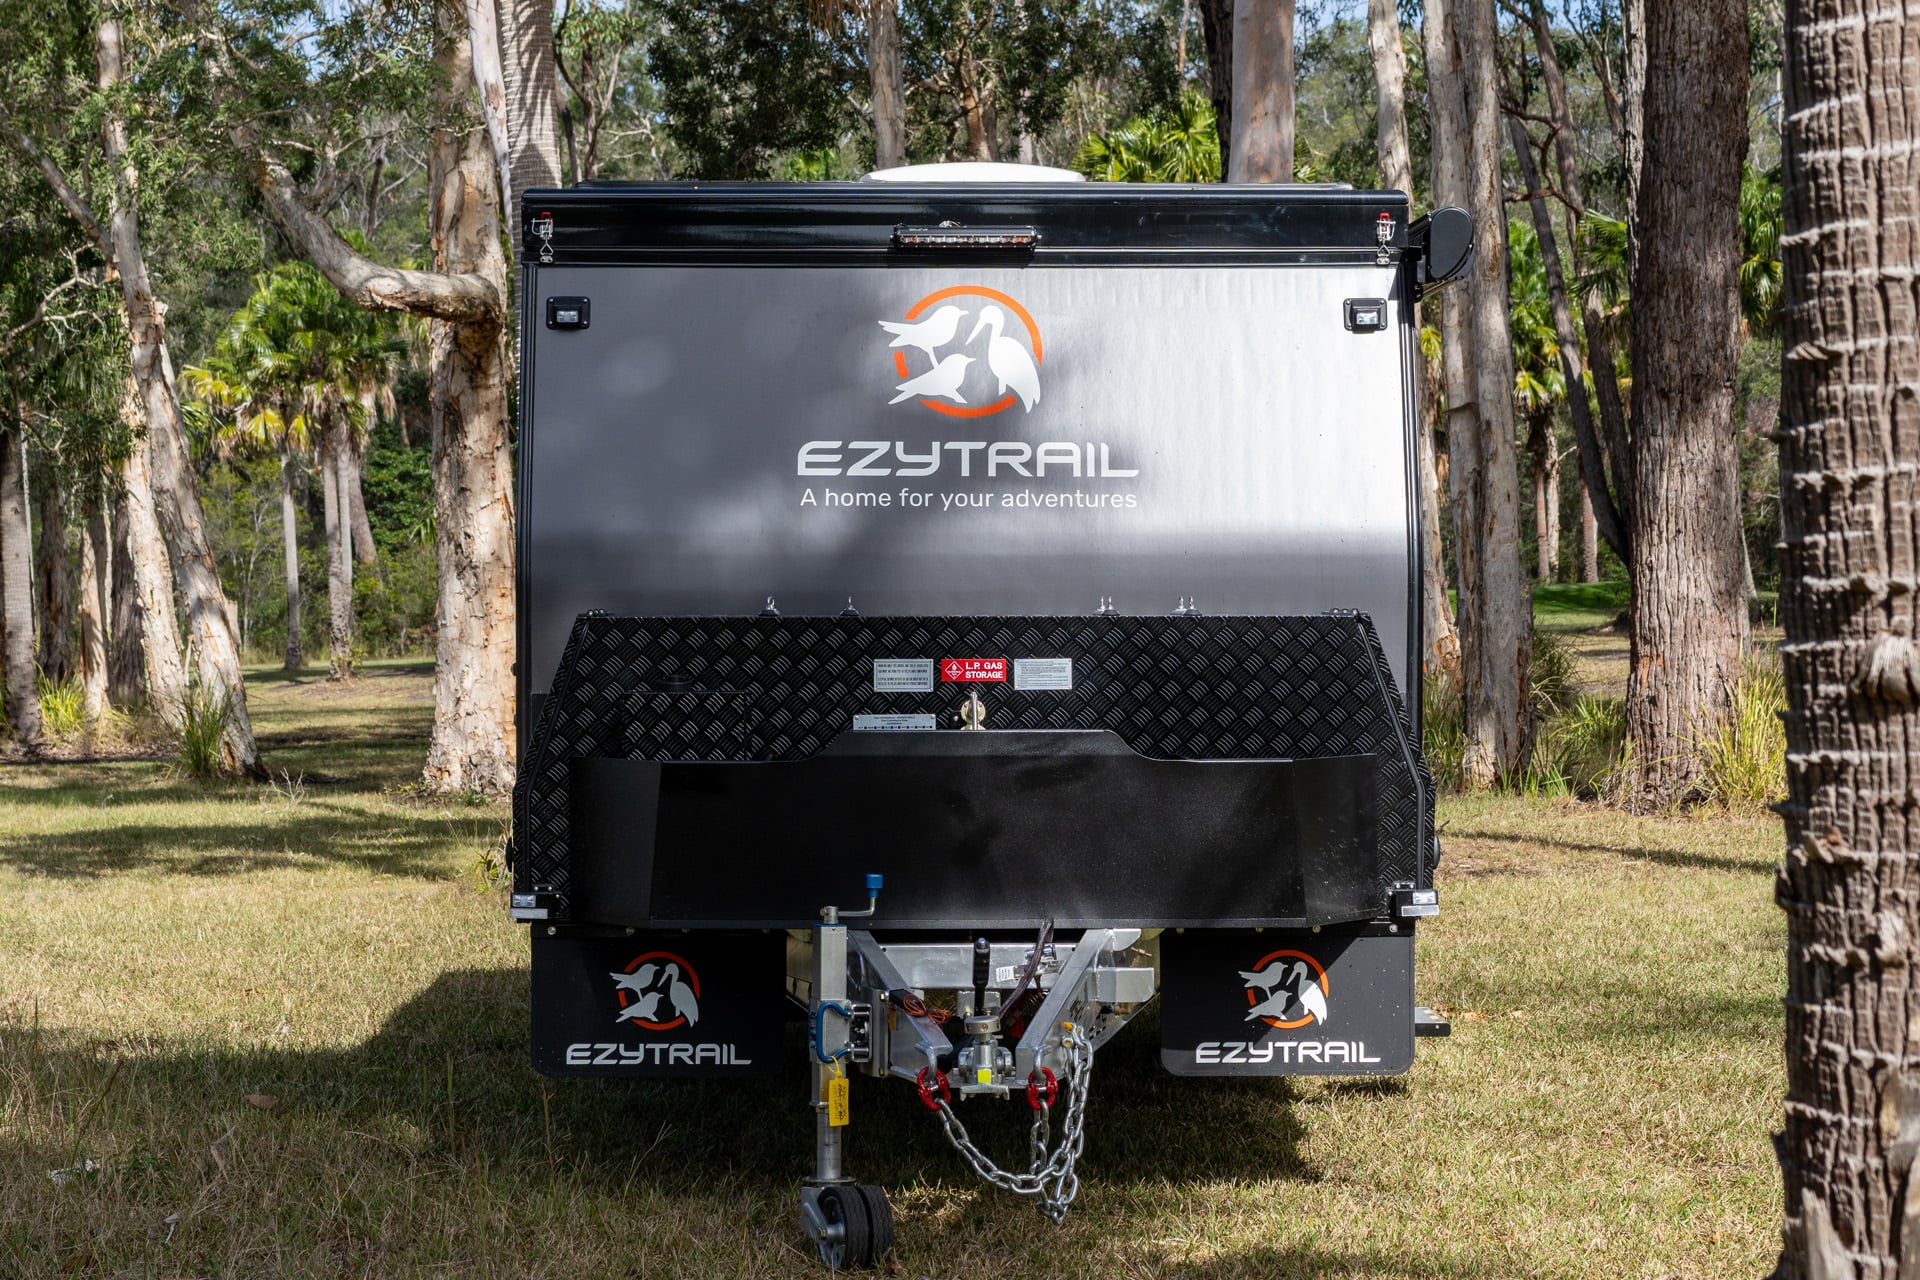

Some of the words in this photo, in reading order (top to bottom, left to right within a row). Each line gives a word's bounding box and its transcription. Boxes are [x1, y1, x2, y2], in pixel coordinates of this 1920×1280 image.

[797, 440, 1140, 478] EZYTRAIL
[800, 488, 817, 507] A
[825, 488, 892, 508] home
[899, 487, 934, 508] for
[941, 492, 994, 511] your
[1001, 488, 1137, 509] adventures
[965, 671, 1004, 679] STORAGE
[983, 662, 1003, 670] GAS
[566, 1043, 752, 1066] EZYTRAIL
[1195, 1041, 1382, 1064] EZYTRAIL
